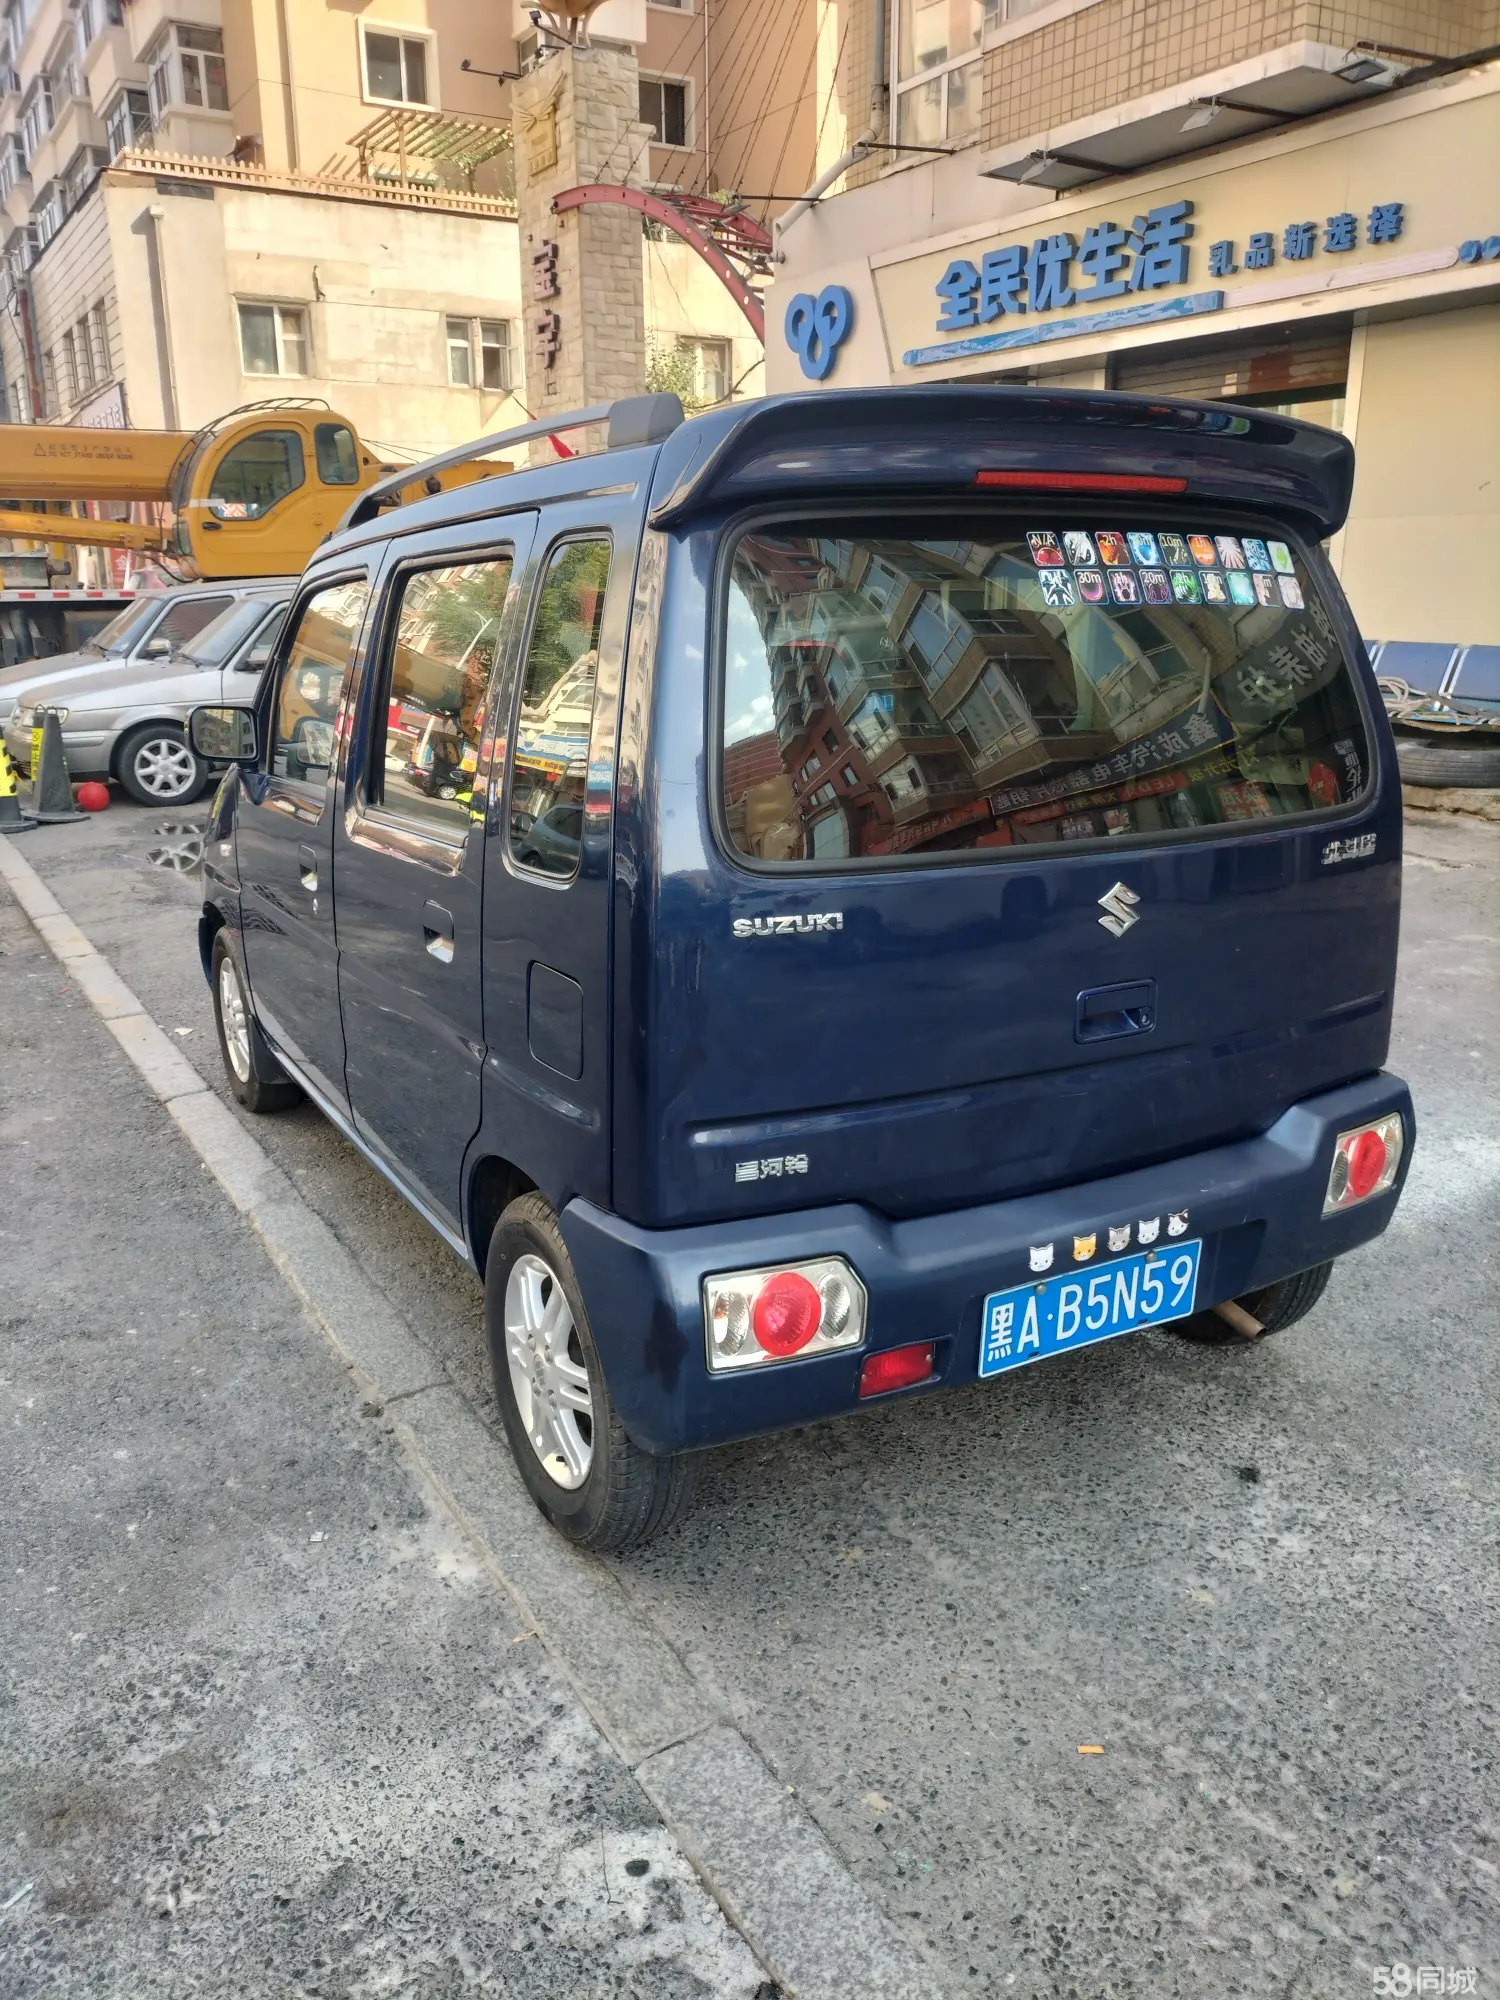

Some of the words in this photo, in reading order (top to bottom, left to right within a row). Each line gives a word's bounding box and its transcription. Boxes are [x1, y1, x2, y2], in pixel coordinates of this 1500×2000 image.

[1209, 202, 1404, 278] 乳品新选择
[936, 200, 1194, 331] 全民优生活
[1032, 533, 1056, 546] N/A
[1103, 534, 1118, 546] 2h
[1162, 535, 1183, 548] 10m
[1077, 571, 1102, 584] 30m
[1143, 571, 1165, 583] 20m
[733, 912, 844, 938] SUZUKI
[987, 1254, 1193, 1362] 黑A·B5N59
